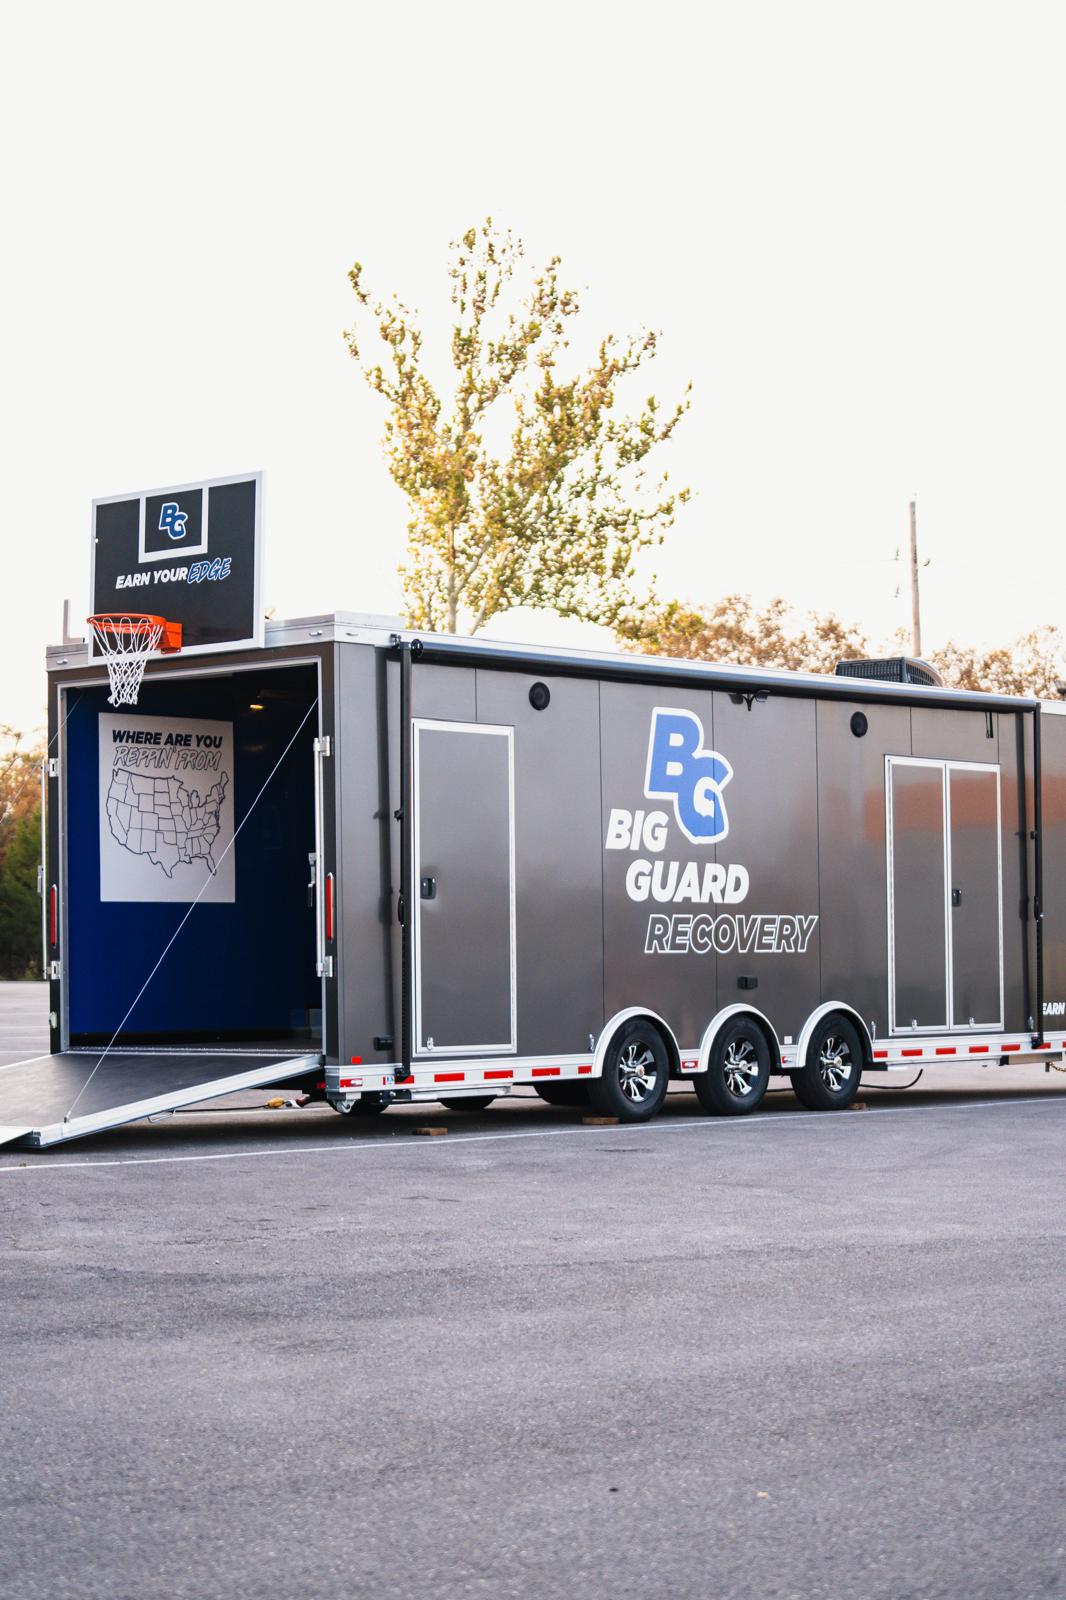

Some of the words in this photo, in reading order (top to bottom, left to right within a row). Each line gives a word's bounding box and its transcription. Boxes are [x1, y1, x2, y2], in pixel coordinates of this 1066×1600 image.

[158, 501, 189, 540] BG
[115, 570, 151, 590] EARN
[153, 566, 188, 585] YOUR
[187, 557, 232, 585] EDGE
[112, 729, 162, 746] WHERE
[164, 732, 192, 748] ARE
[195, 734, 223, 749] YOU
[113, 745, 177, 768] REPPIN'
[174, 748, 222, 771] FROM
[643, 706, 734, 845] BG
[605, 808, 669, 853] BIG
[625, 858, 750, 905] GUARD
[644, 913, 819, 954] RECOVERY
